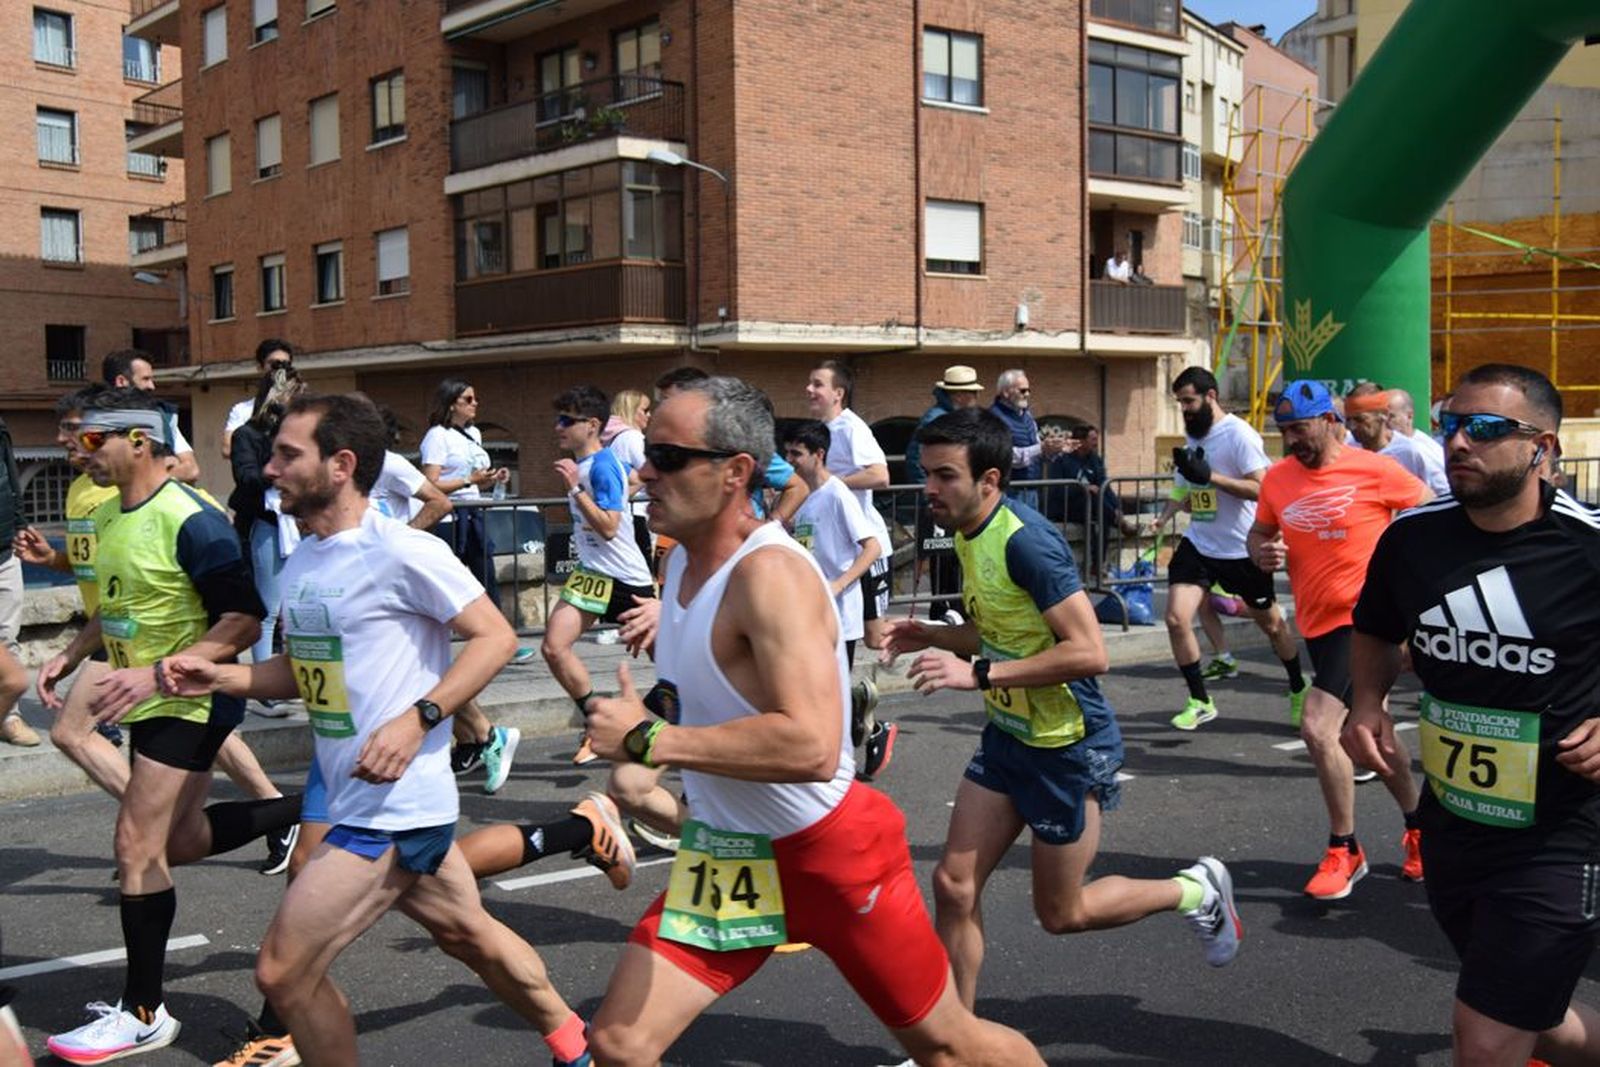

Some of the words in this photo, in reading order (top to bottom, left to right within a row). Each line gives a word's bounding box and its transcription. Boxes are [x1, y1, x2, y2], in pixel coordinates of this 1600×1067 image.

[72, 537, 90, 561] 43
[570, 576, 606, 598] 200
[1413, 626, 1556, 675] adidas
[299, 666, 329, 705] 32
[1444, 709, 1520, 729] FUNDACION
[1444, 720, 1474, 734] CAJA
[1476, 724, 1520, 739] RURAL
[1439, 735, 1498, 789] 75
[1444, 792, 1475, 811] CAJA
[1477, 802, 1526, 821] RURAL
